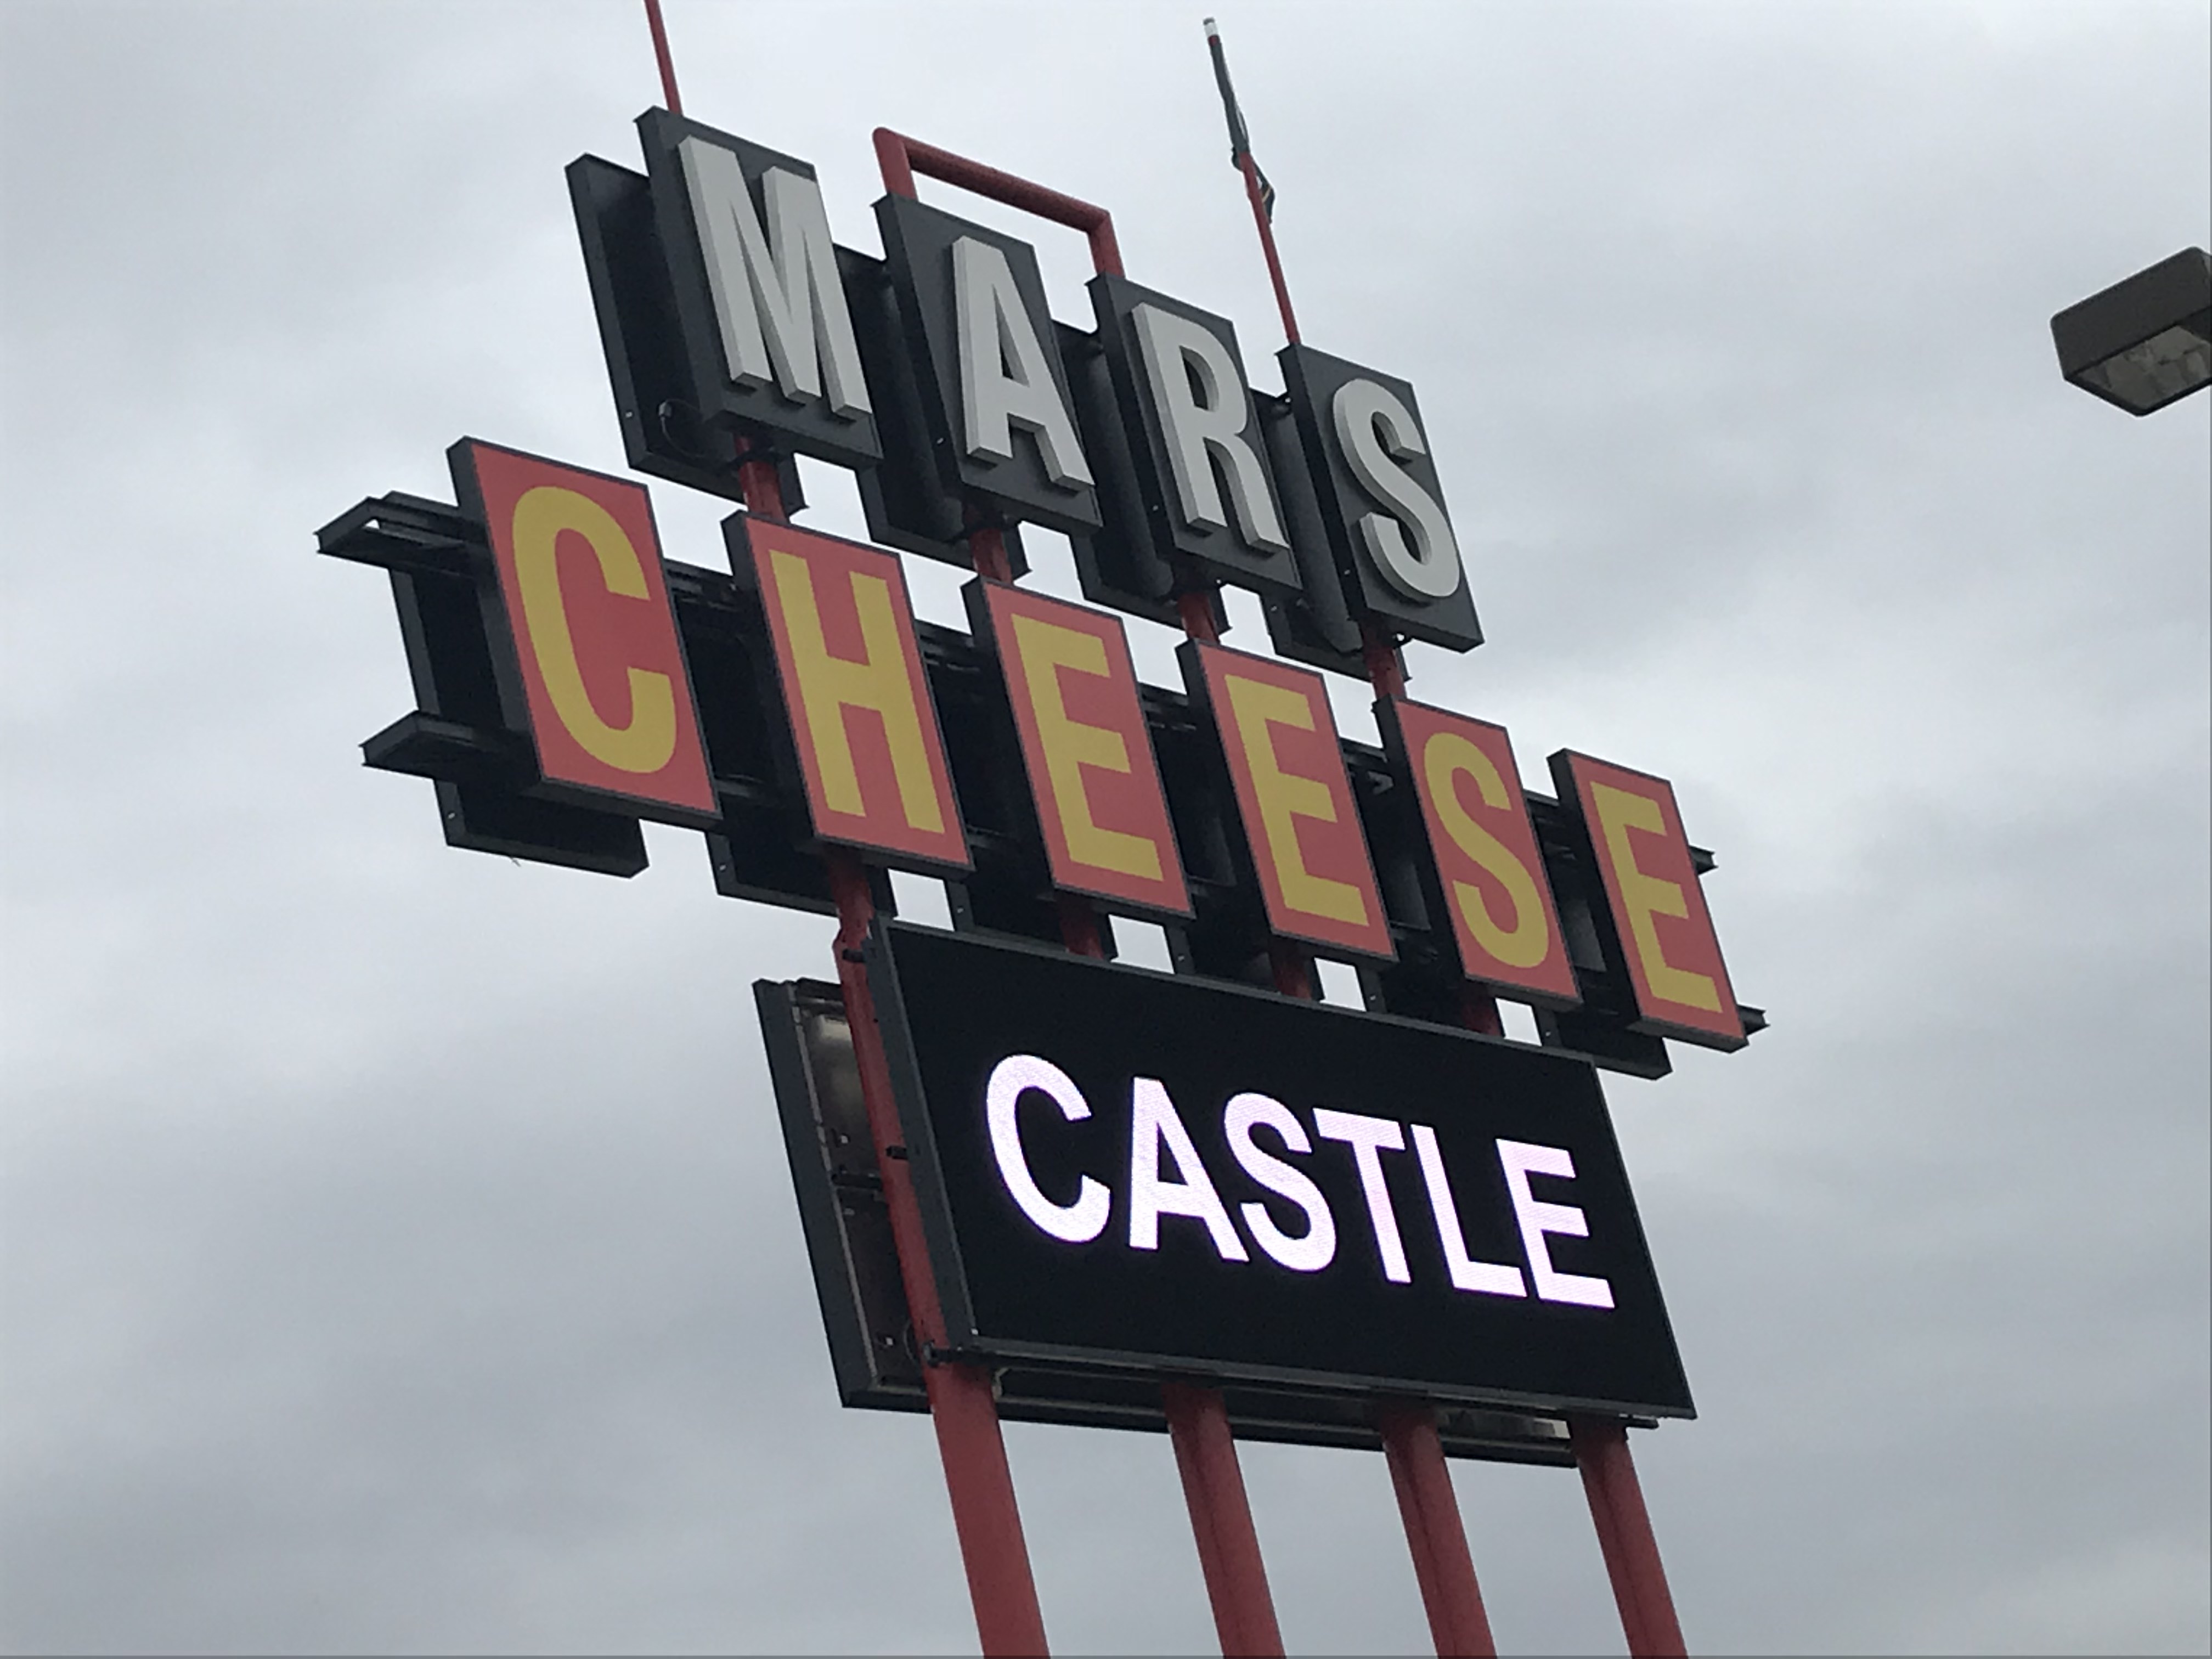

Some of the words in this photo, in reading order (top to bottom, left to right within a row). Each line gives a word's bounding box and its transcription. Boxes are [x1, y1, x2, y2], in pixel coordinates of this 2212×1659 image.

[678, 135, 1460, 602] MARS
[512, 486, 1723, 1013] CHEESE
[985, 1054, 1615, 1309] CASTLE
